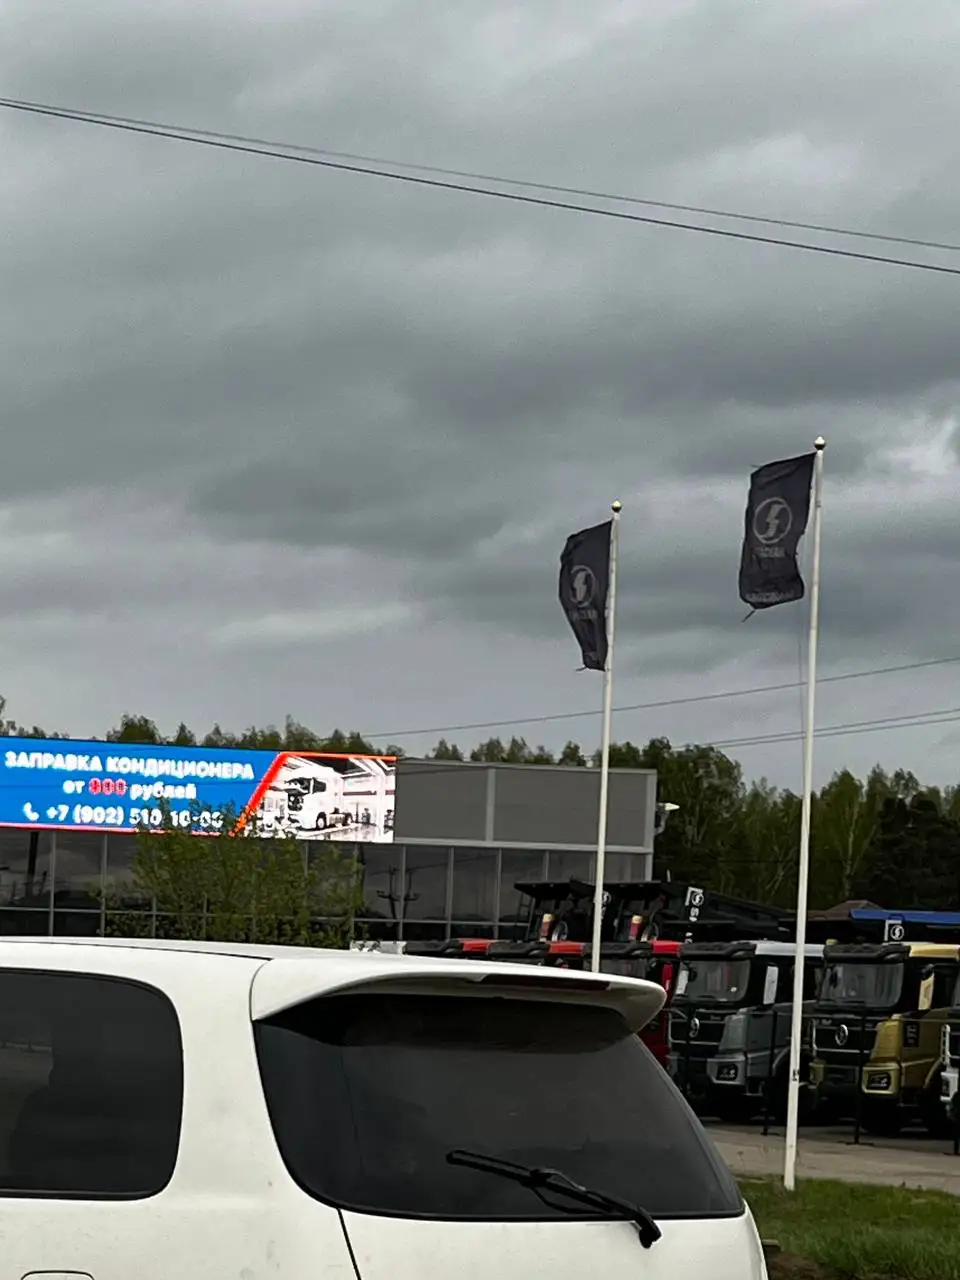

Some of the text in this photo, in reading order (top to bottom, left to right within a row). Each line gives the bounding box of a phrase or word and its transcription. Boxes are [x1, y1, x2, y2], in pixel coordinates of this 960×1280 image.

[5, 751, 254, 780] ЗАПРАВКА КОНДИЦИОНЕРА
[62, 780, 85, 794] от
[130, 783, 196, 800] рублей
[46, 804, 69, 822] +7
[73, 804, 124, 825] (902)
